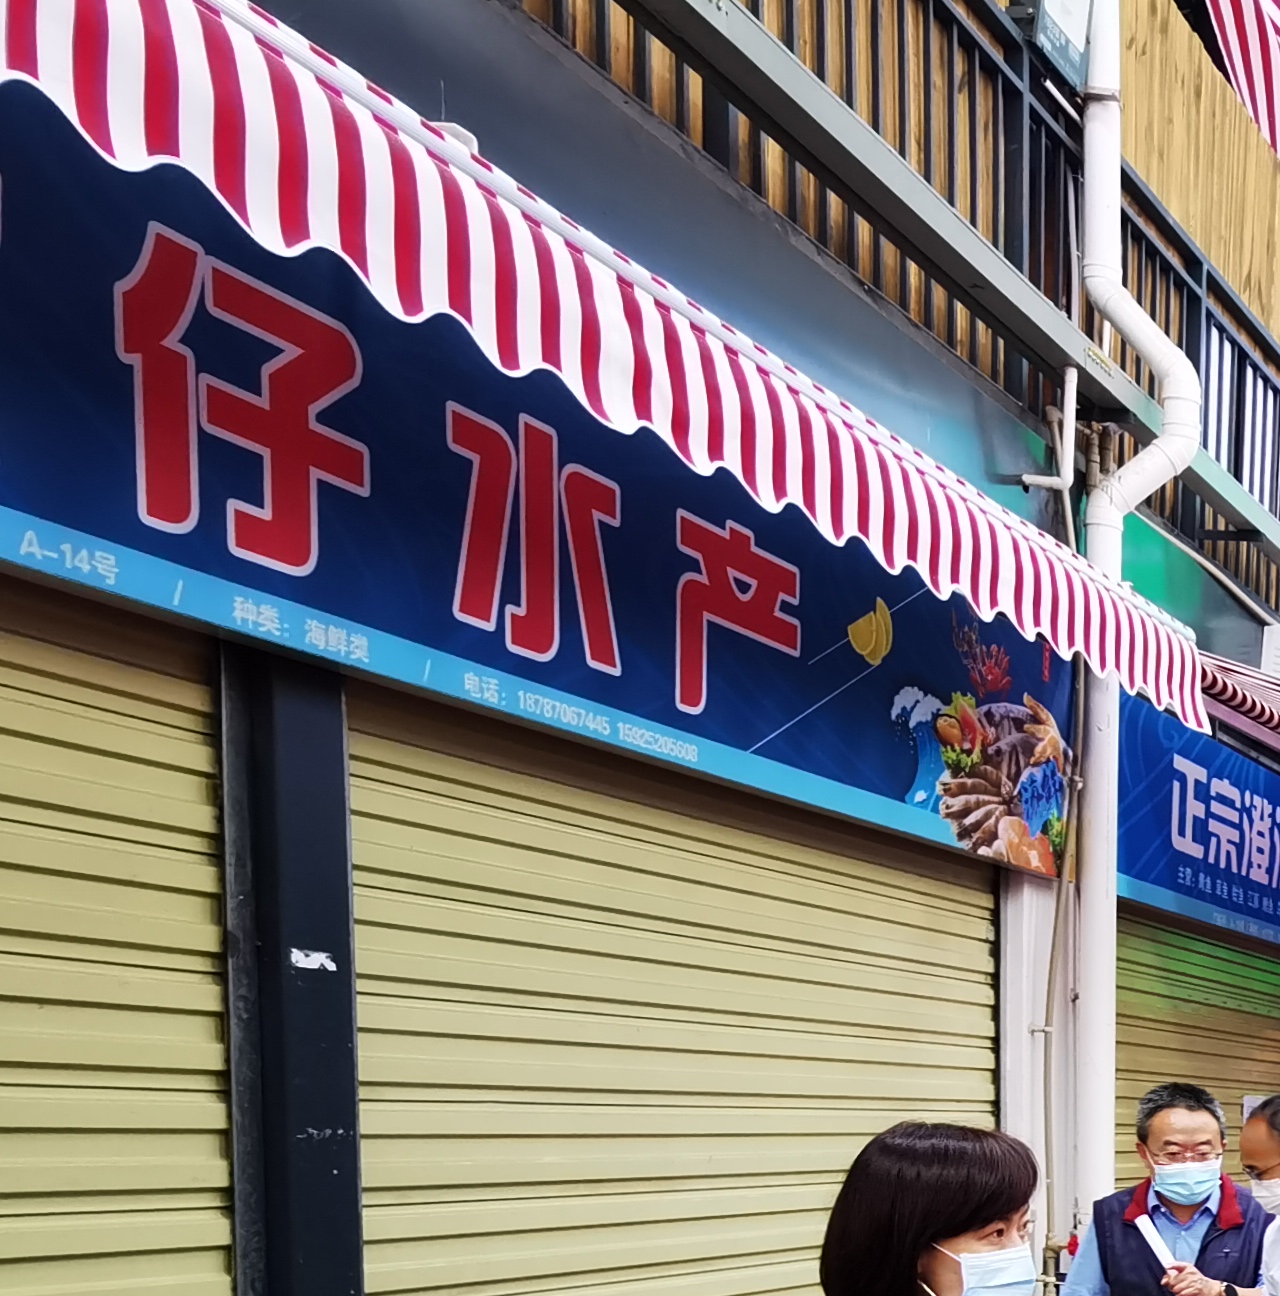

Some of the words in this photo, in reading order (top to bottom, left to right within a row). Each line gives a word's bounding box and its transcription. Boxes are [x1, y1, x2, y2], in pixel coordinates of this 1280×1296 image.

[20, 529, 120, 586] A-14号
[113, 220, 801, 716] 仔水产
